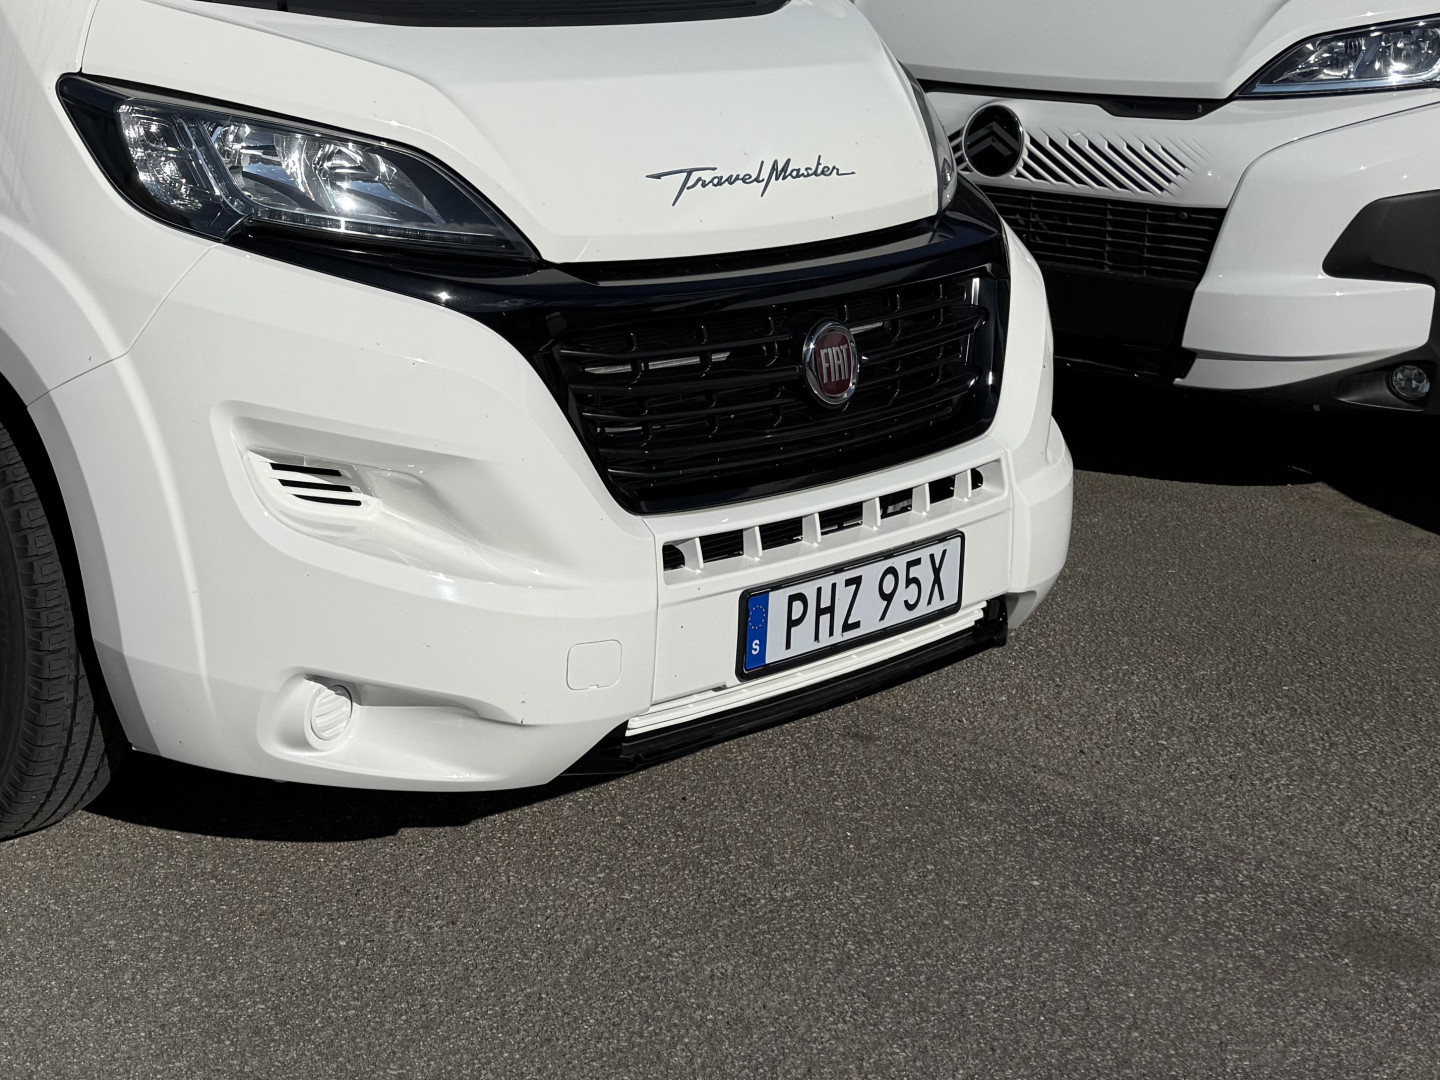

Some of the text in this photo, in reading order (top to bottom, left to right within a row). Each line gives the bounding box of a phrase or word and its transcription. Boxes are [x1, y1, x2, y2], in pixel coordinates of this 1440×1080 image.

[820, 343, 849, 384] FIAT
[784, 548, 948, 651] PHZ 95X
[751, 639, 760, 655] S
